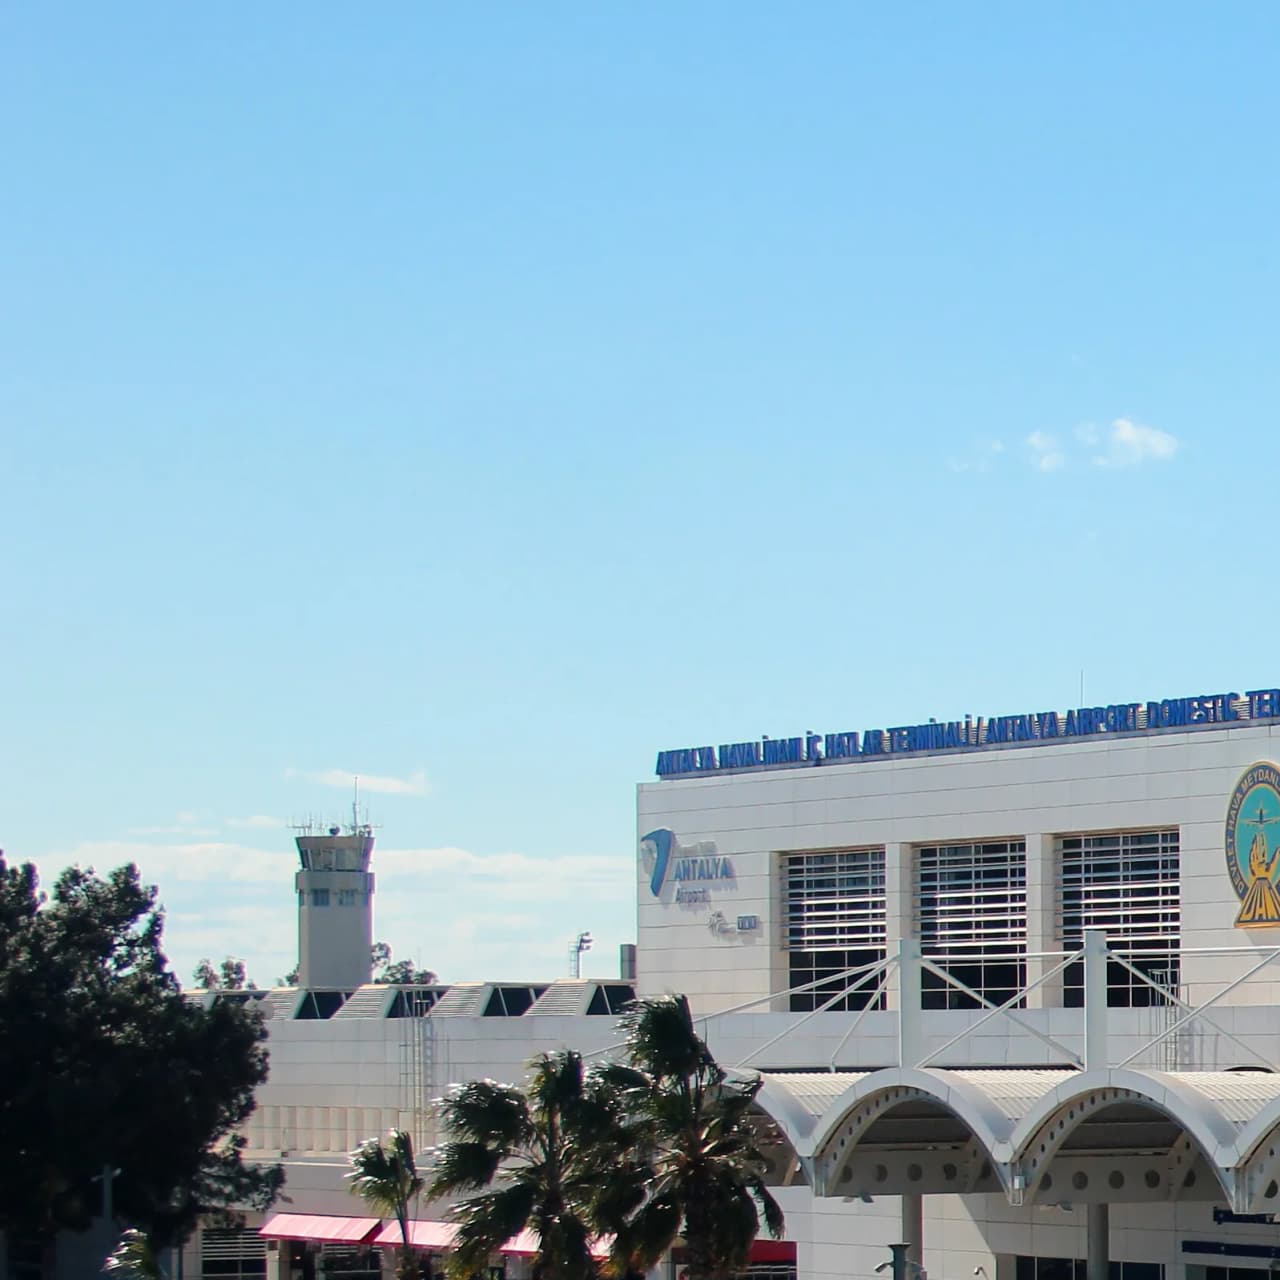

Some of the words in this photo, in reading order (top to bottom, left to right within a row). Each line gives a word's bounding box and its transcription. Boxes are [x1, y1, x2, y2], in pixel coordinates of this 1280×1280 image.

[656, 746, 718, 775] ANTALYA
[825, 729, 883, 759] HATLAR
[986, 712, 1060, 744] ANTALYA
[1064, 703, 1143, 736] AIRPORT
[1146, 692, 1241, 729] DOMESTIC
[1227, 793, 1243, 831] HAVA
[674, 857, 734, 880] ANTALYA
